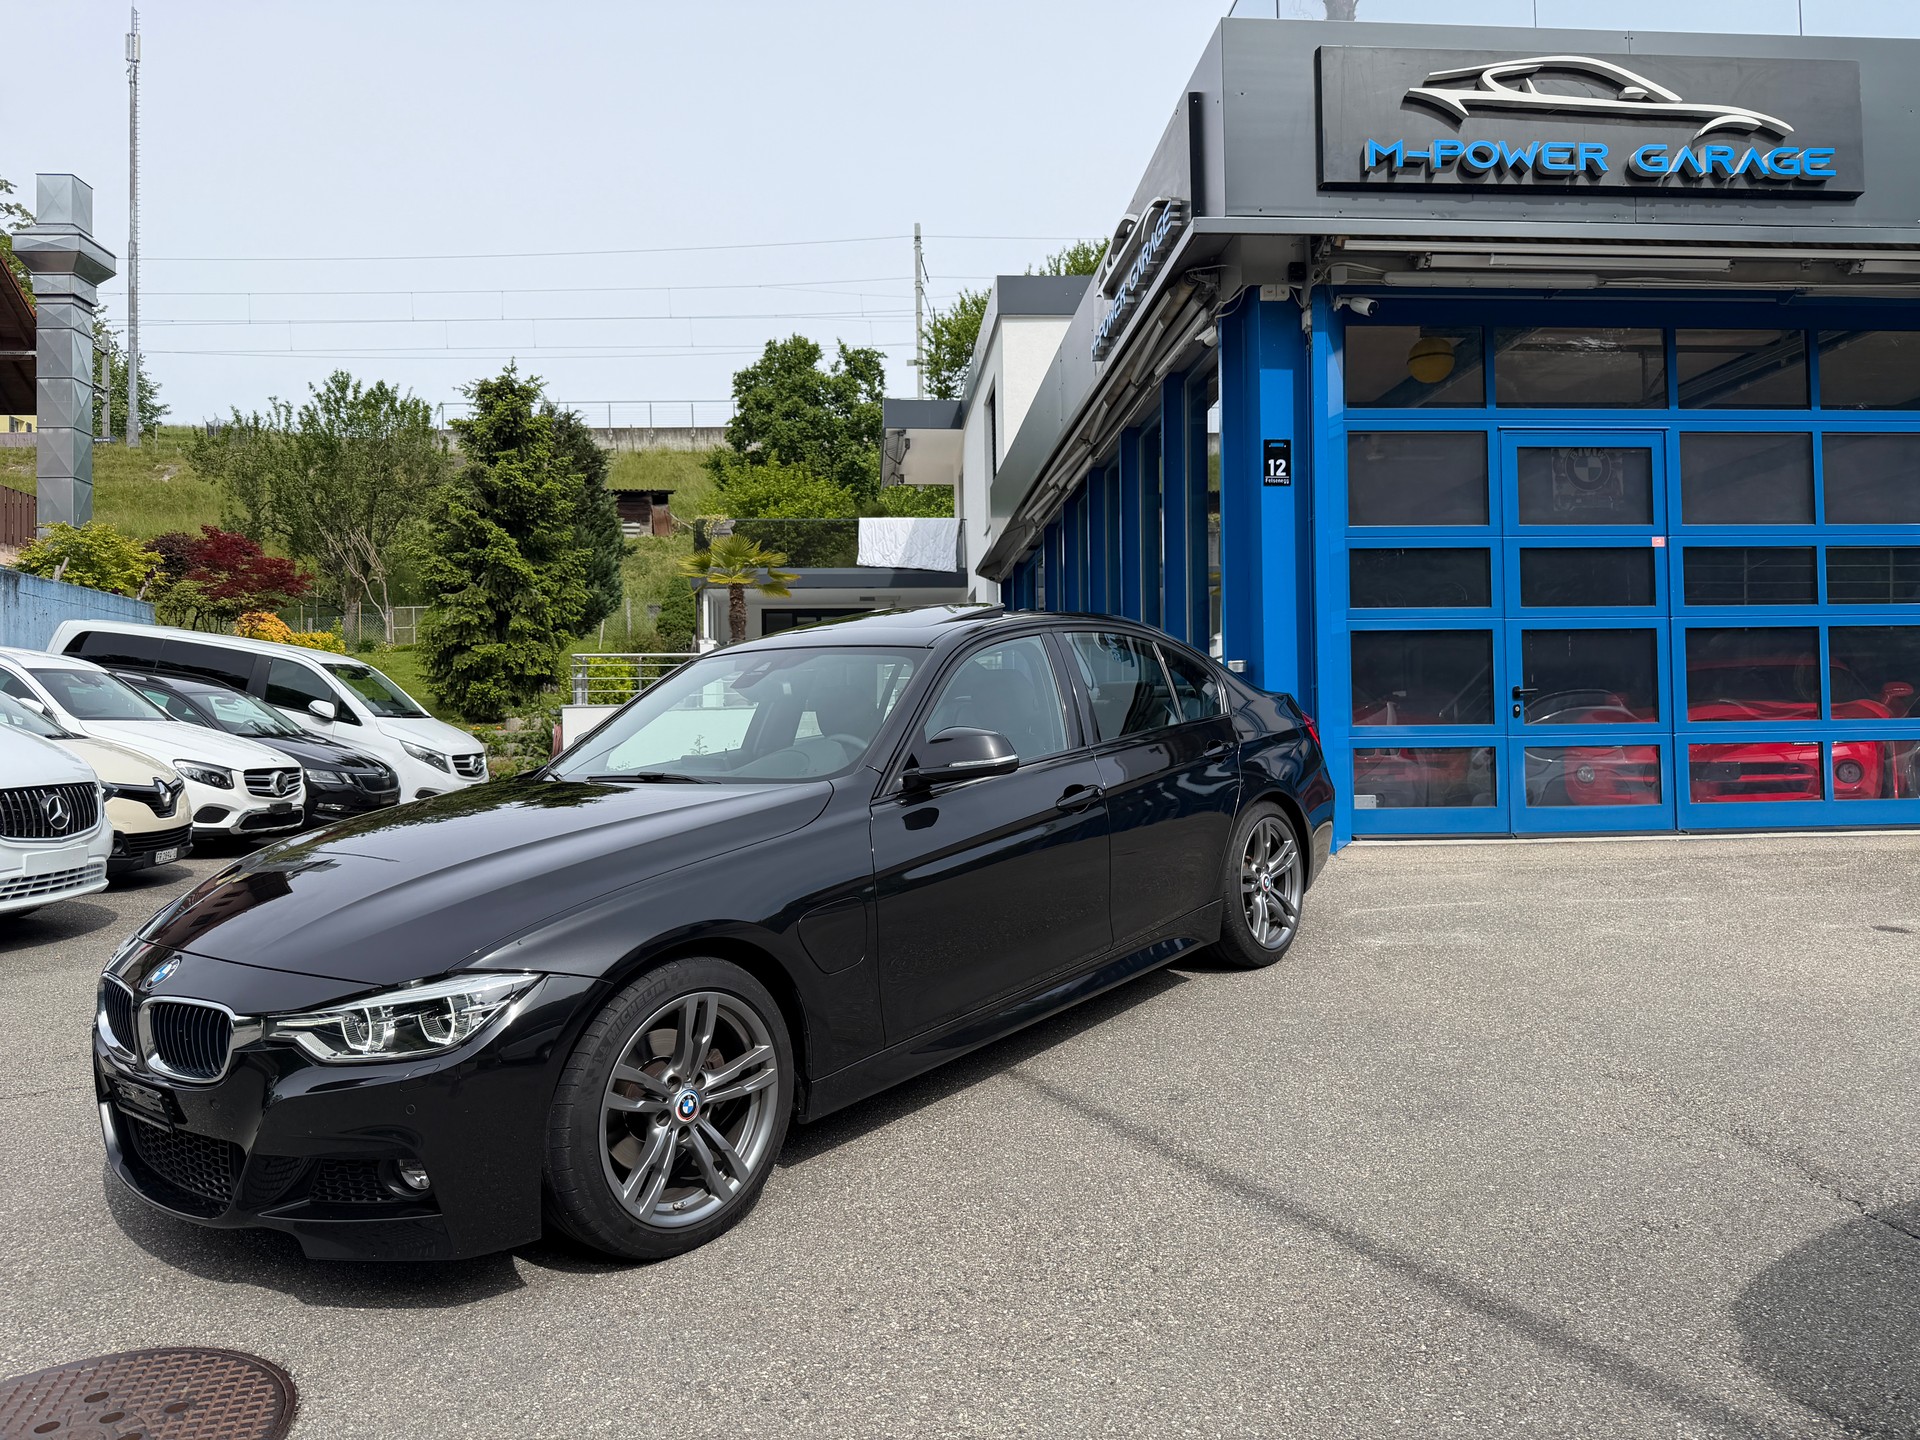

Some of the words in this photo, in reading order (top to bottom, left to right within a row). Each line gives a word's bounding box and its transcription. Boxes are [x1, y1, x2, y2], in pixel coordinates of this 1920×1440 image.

[1368, 138, 1609, 171] M-POWER
[1635, 143, 1837, 177] GARAGE
[1129, 200, 1172, 291] GARAGE
[1268, 458, 1287, 476] 12
[608, 979, 668, 1042] MICHELIN
